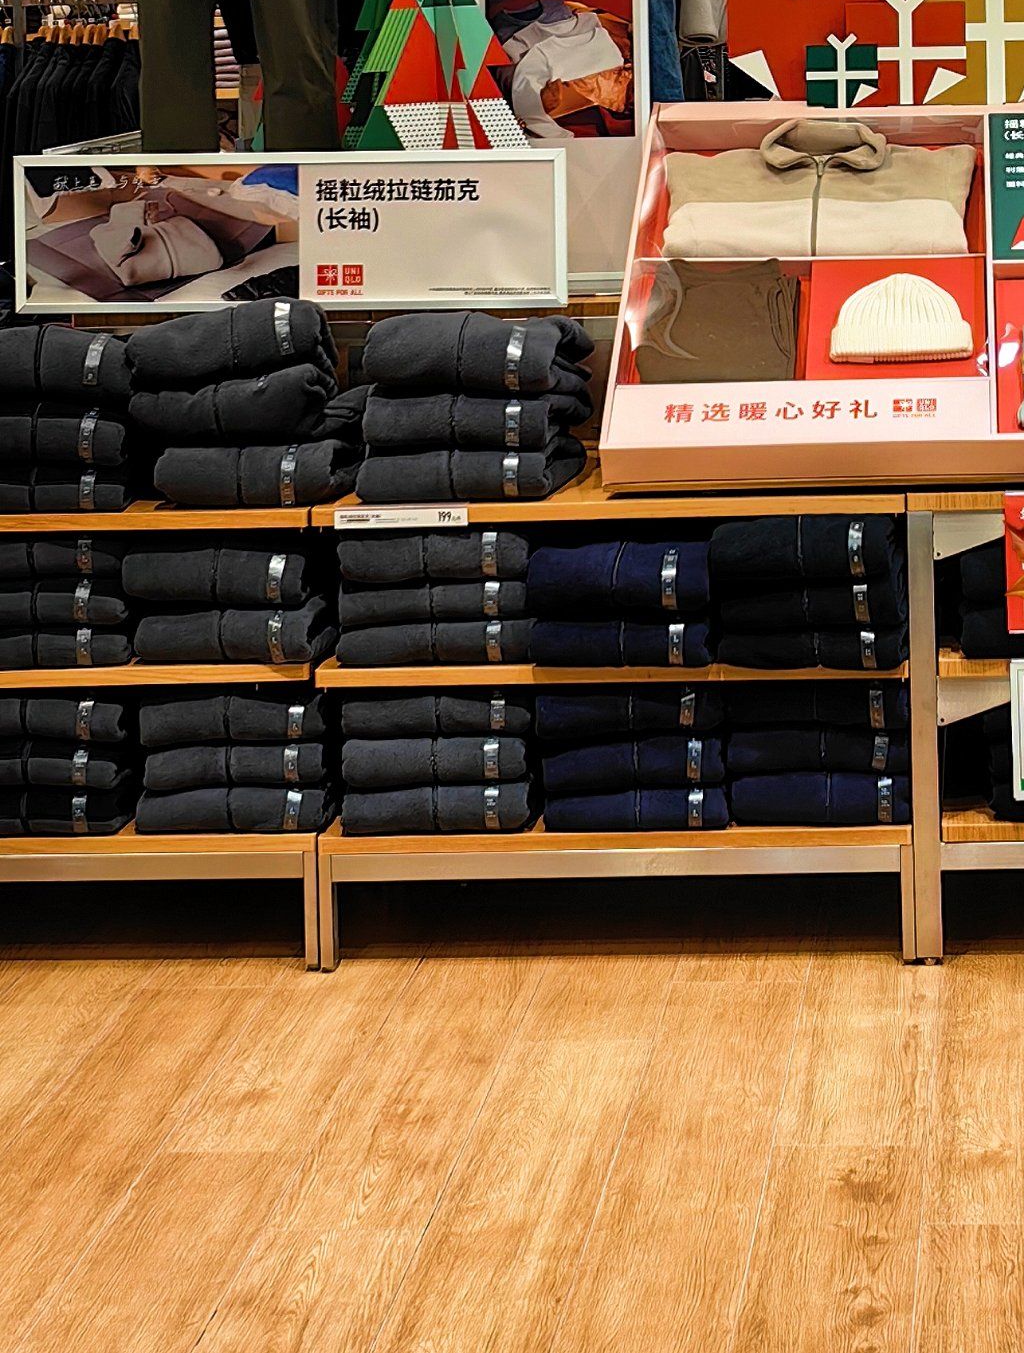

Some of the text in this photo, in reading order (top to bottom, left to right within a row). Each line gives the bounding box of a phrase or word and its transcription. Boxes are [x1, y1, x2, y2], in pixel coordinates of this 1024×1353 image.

[315, 178, 480, 202] 摇粒绒拉链茄克
[317, 208, 379, 232] (长袖)
[664, 399, 877, 423] 精选暖心好礼
